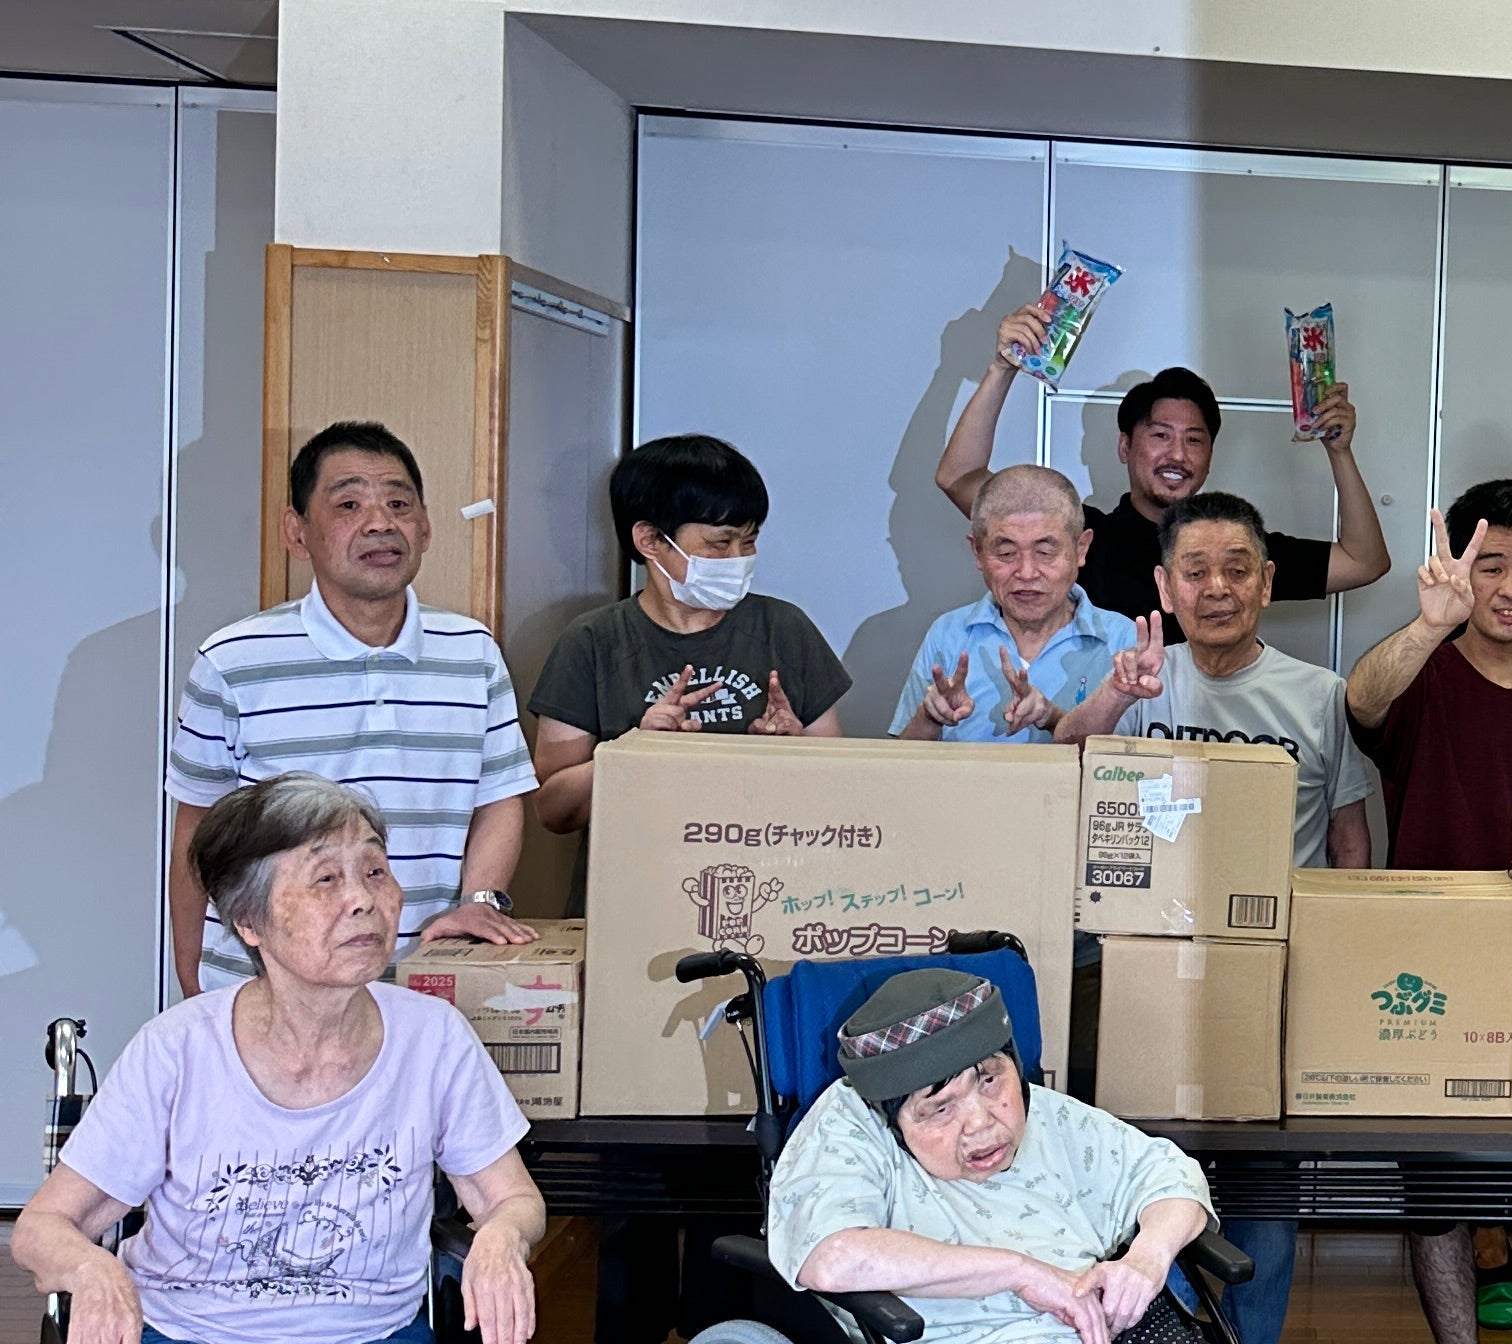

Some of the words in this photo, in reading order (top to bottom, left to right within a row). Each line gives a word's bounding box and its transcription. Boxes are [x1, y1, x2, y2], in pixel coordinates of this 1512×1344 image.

[1093, 765, 1145, 782] Calbee
[1096, 801, 1140, 816] 6500
[683, 822, 883, 849] 290g(チャック付き)
[1091, 869, 1145, 886] 30067
[781, 889, 834, 915] ホップ!
[839, 884, 907, 913] ステップ!
[913, 881, 965, 907] コーン!
[792, 922, 957, 956] ポップコーン
[423, 976, 454, 987] 2025
[1370, 989, 1448, 1016] つぶグミ
[1378, 1028, 1438, 1041] 濃厚ぶどう
